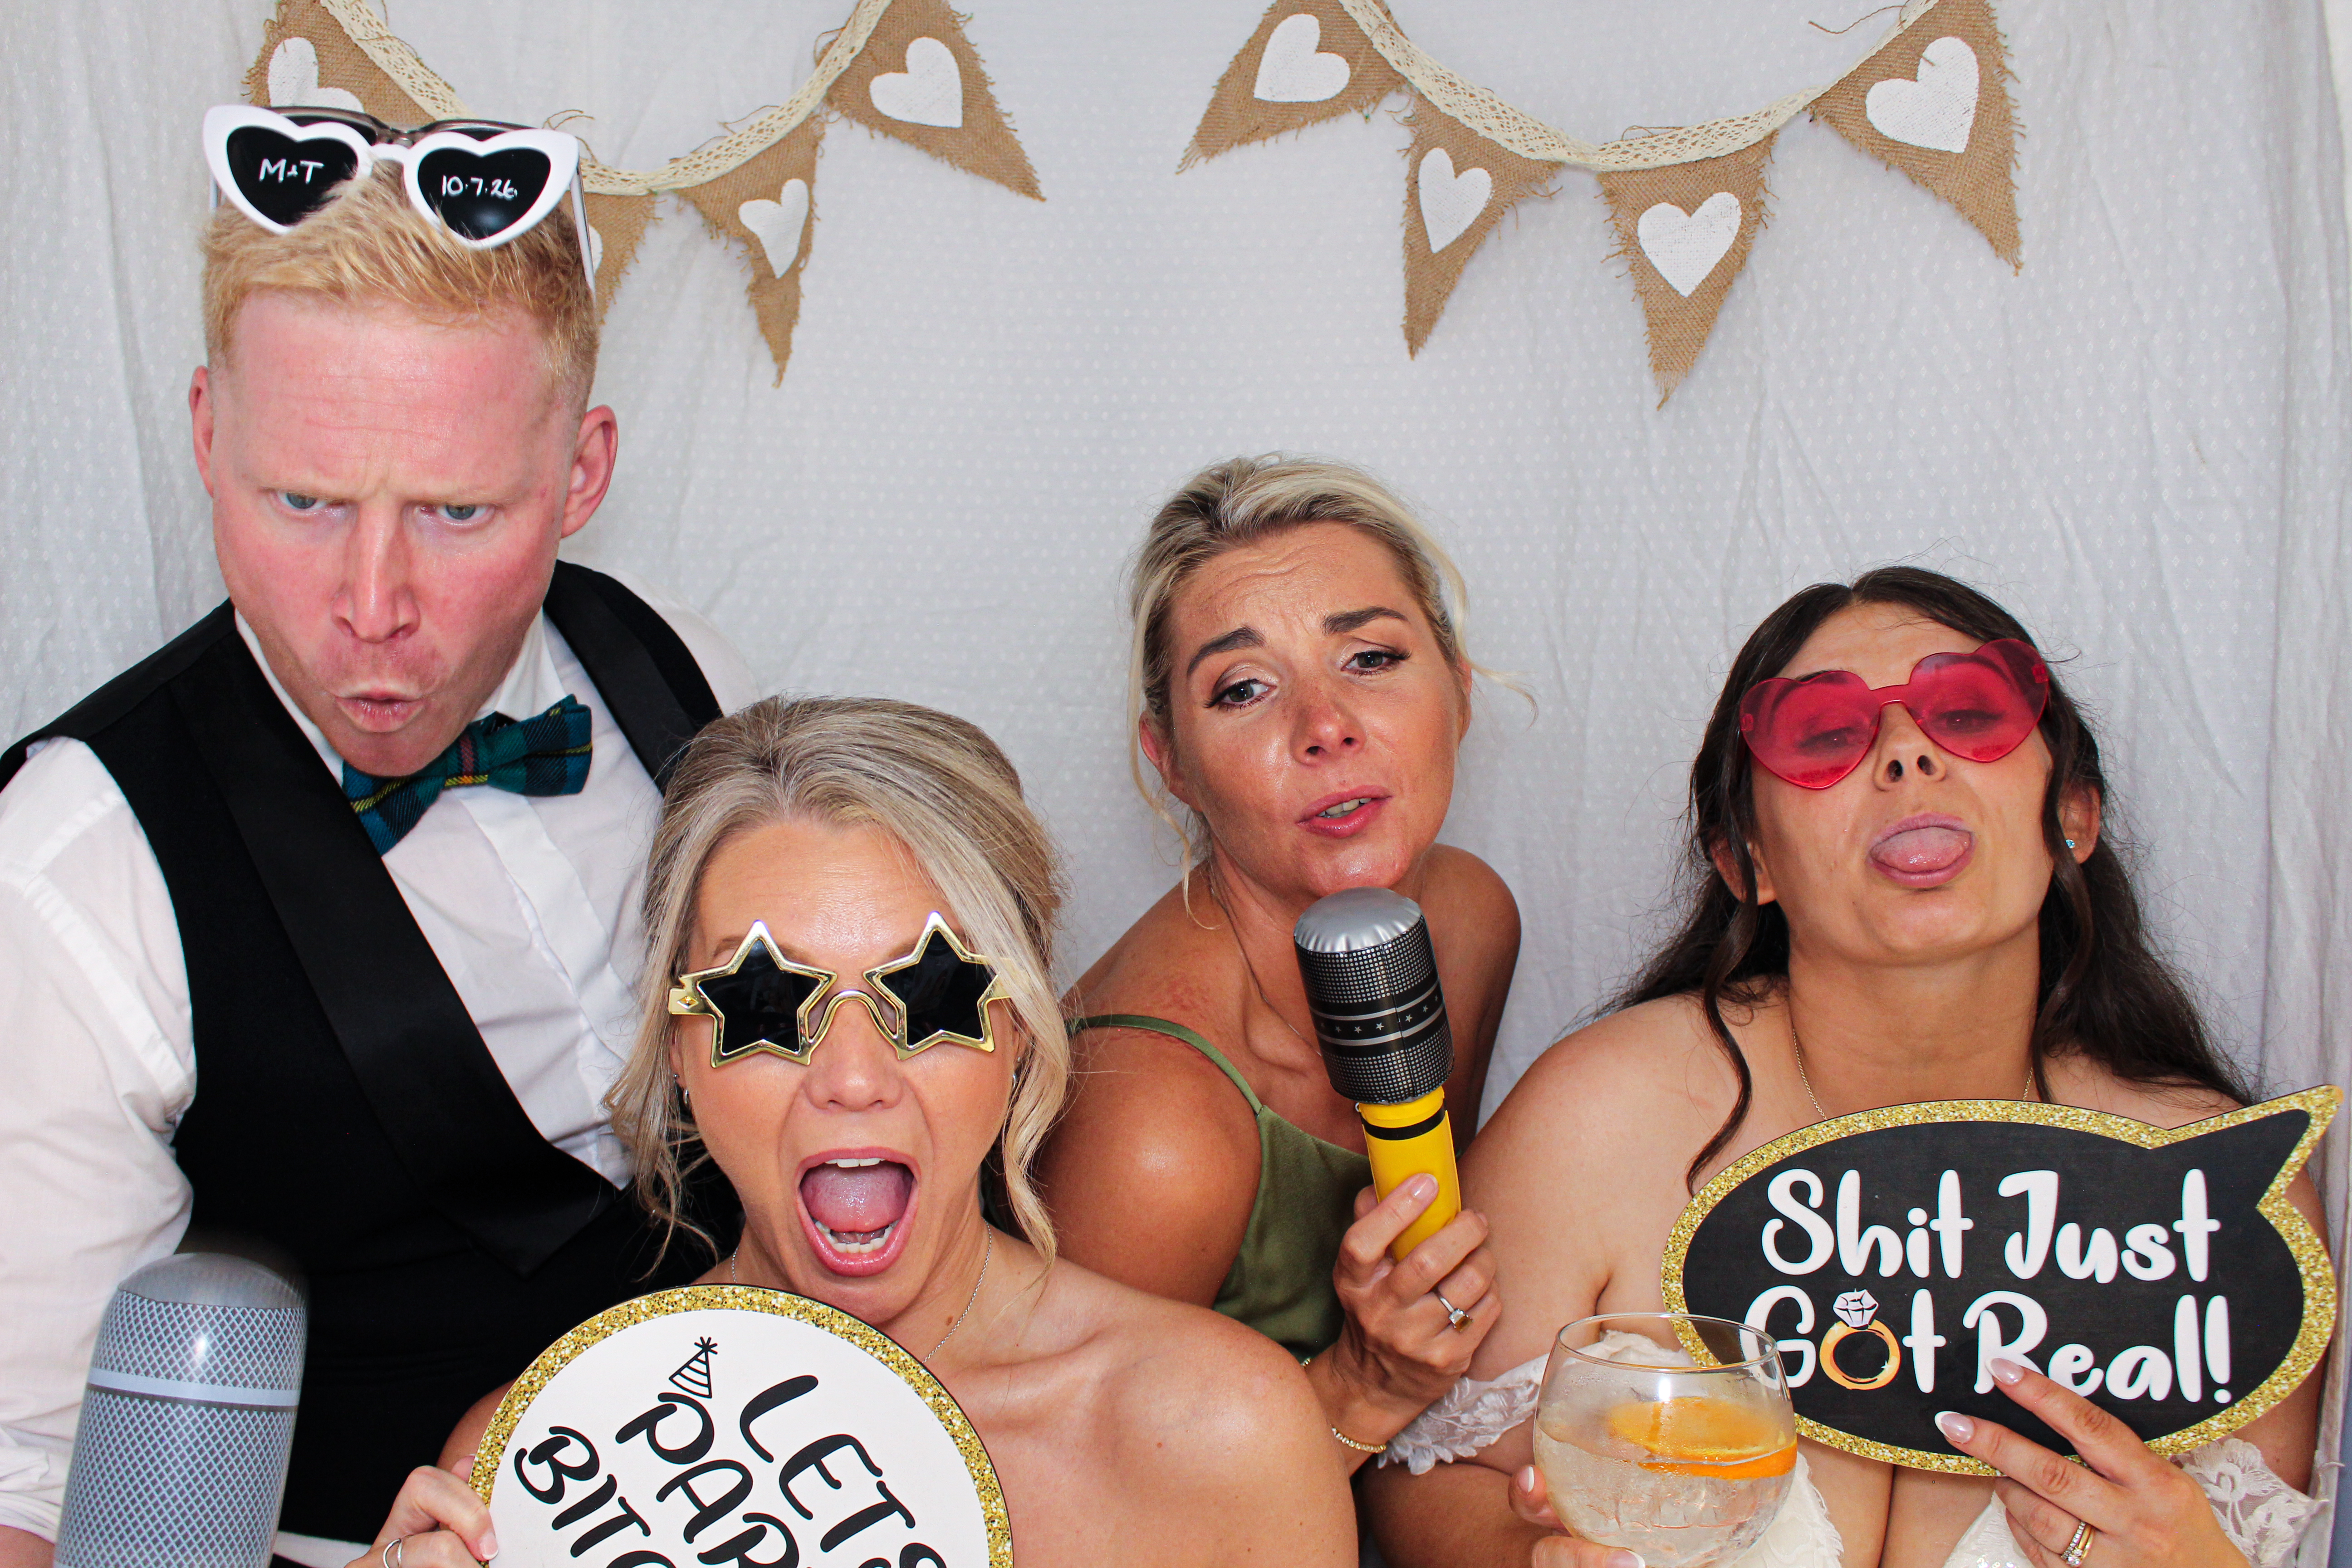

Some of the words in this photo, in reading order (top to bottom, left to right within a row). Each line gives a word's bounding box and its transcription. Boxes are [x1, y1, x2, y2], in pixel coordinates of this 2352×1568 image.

[1761, 1168, 1974, 1279] Shit
[1998, 1168, 2221, 1284] Just
[1962, 1290, 2232, 1404] Real!
[514, 1426, 676, 1568] BIT
[615, 1392, 813, 1568] PAR
